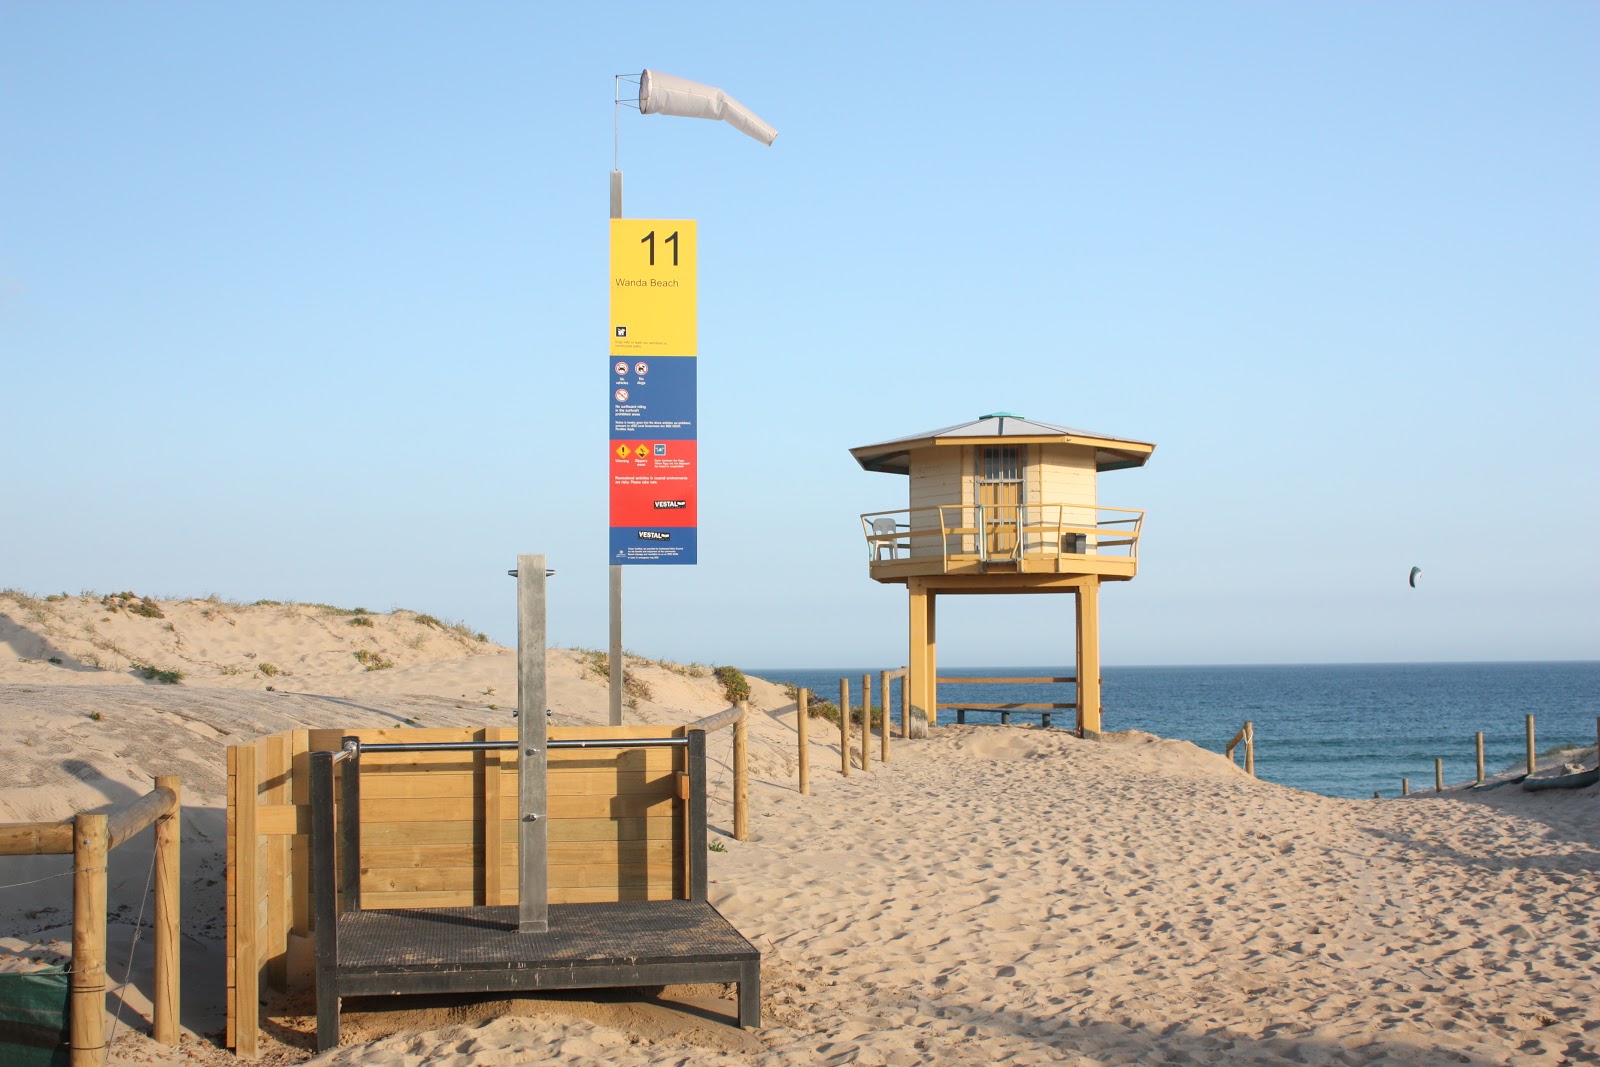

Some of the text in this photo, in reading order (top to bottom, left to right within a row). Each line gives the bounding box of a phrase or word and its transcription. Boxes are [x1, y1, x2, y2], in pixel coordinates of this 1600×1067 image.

[641, 230, 679, 266] 11
[615, 278, 679, 288] Wanda Beach
